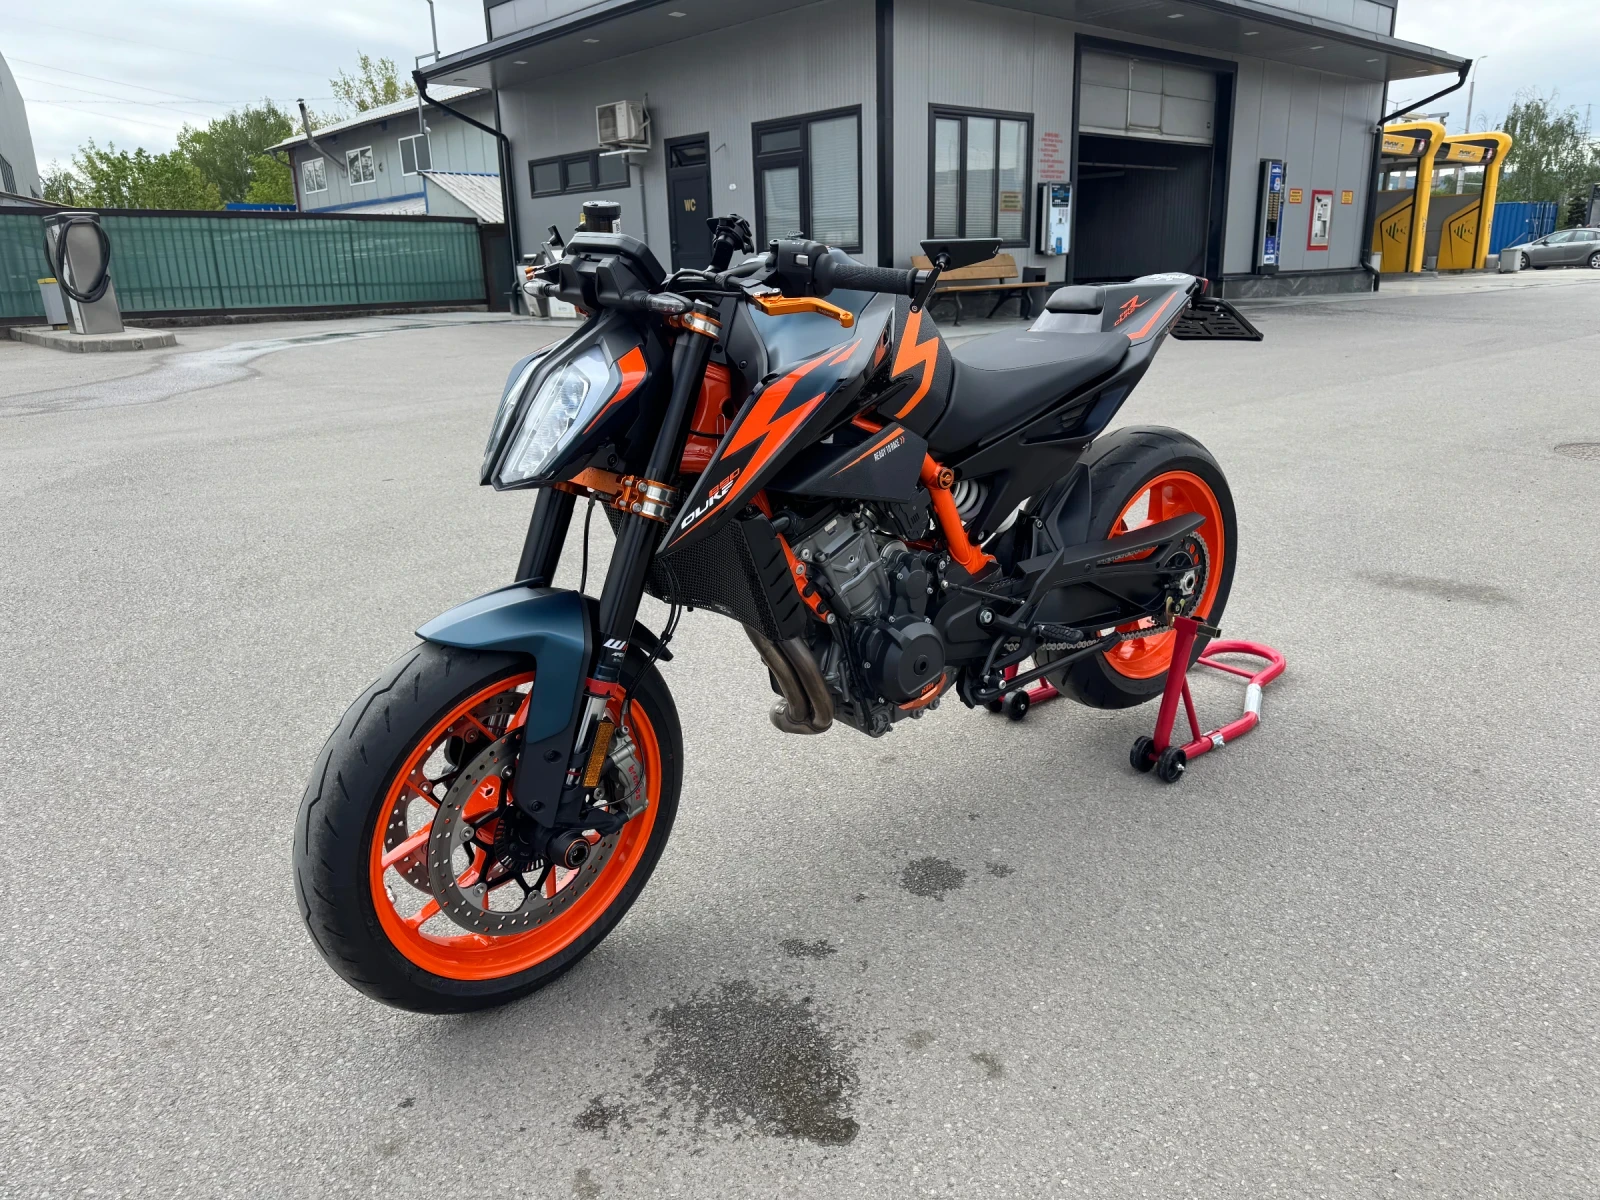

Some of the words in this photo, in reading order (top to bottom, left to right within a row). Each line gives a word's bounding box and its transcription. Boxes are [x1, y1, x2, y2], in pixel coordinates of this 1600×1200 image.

[683, 198, 696, 211] WC
[873, 447, 887, 462] READY
[885, 443, 892, 454] TO
[889, 438, 901, 451] RACE
[708, 467, 740, 497] 890
[680, 480, 734, 530] DUKE
